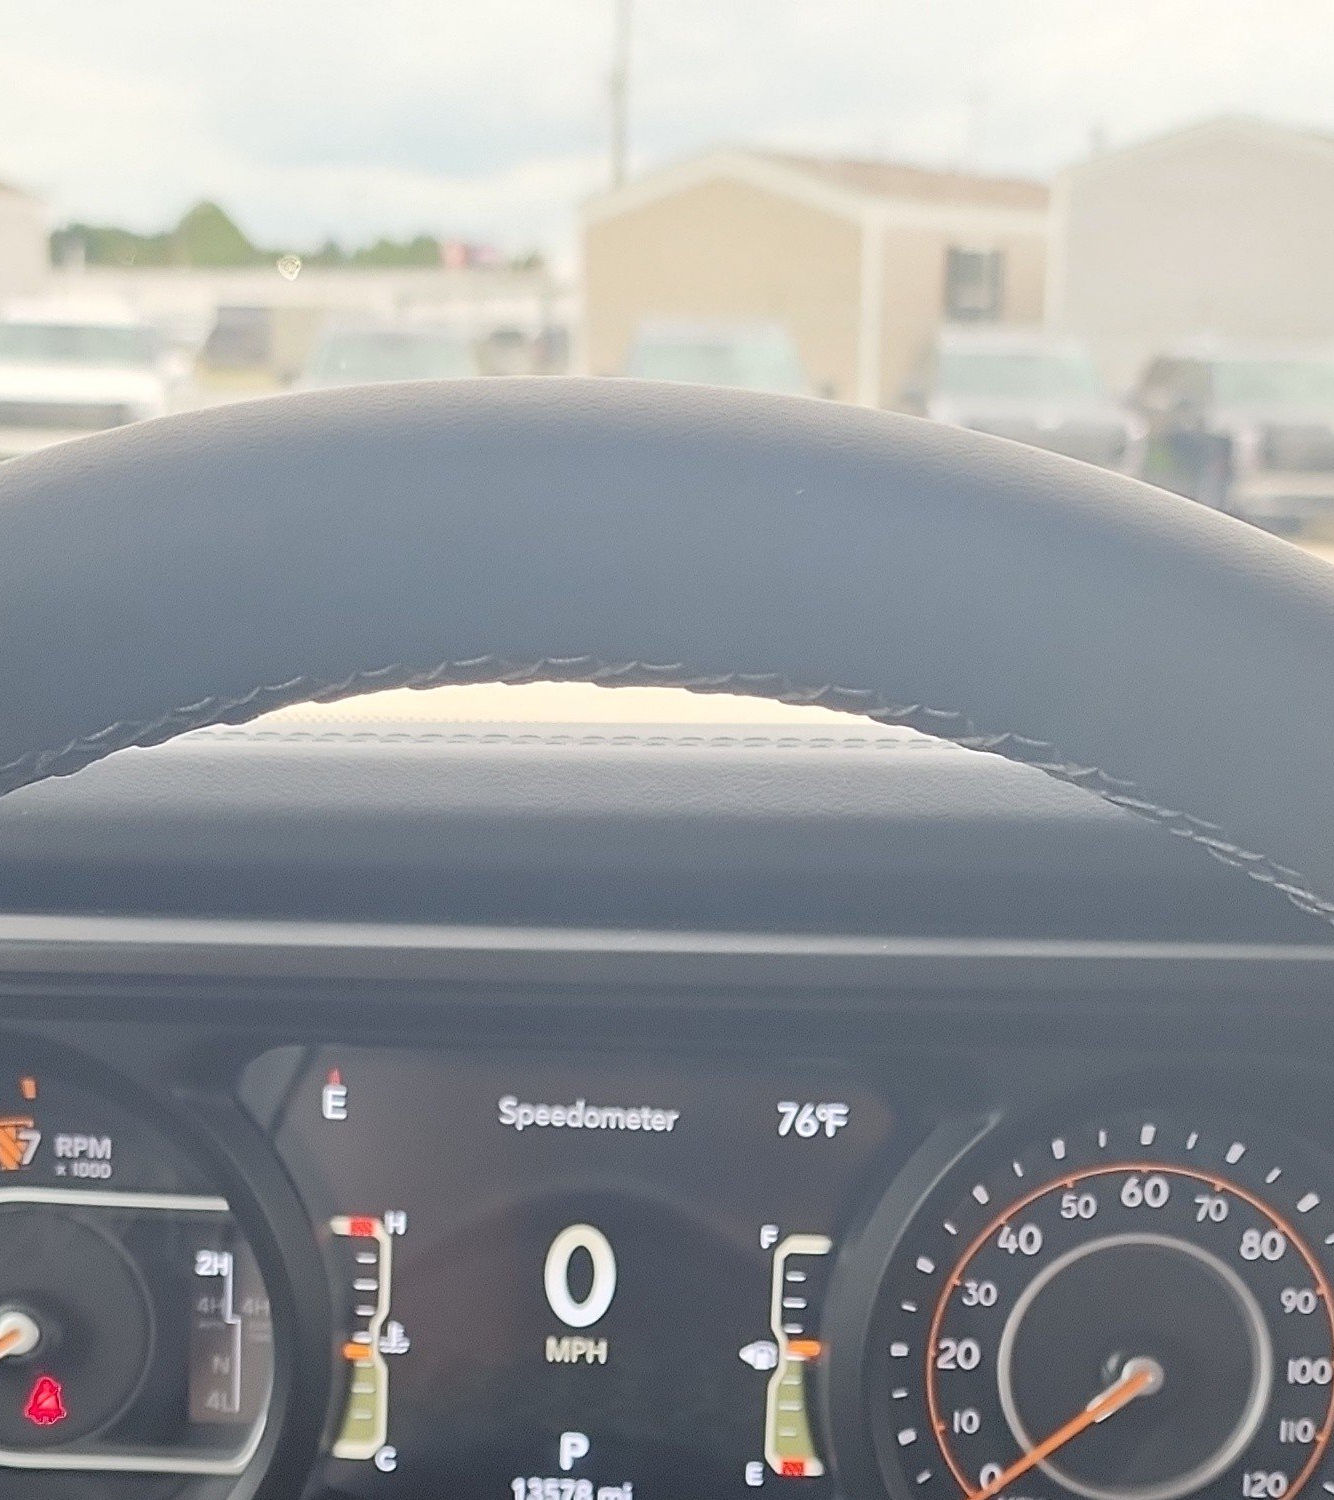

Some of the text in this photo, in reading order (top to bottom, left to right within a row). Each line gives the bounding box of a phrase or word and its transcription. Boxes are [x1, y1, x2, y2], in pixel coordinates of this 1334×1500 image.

[322, 1084, 348, 1120] E
[498, 1096, 680, 1134] Speedometer
[19, 1131, 42, 1164] 7
[54, 1136, 112, 1160] RPM
[71, 1161, 112, 1179] 1000
[1060, 1193, 1098, 1221] 50
[1120, 1177, 1170, 1209] 60
[384, 1211, 407, 1236] H
[1195, 1197, 1228, 1223] 70
[759, 1225, 778, 1249] F
[998, 1223, 1042, 1257] 40
[1239, 1228, 1286, 1262] 80
[194, 1250, 234, 1277] 2H
[544, 1223, 618, 1328] 0
[961, 1281, 998, 1307] 30
[1280, 1289, 1317, 1316] 90
[545, 1336, 608, 1366] MPH
[936, 1338, 981, 1371] 20
[1287, 1357, 1334, 1386] 100
[953, 1409, 980, 1435] 10
[1280, 1418, 1314, 1444] 110
[374, 1447, 398, 1472] C
[560, 1432, 590, 1471] P
[745, 1461, 765, 1487] E
[979, 1462, 1004, 1490] 0
[1242, 1471, 1288, 1499] 120
